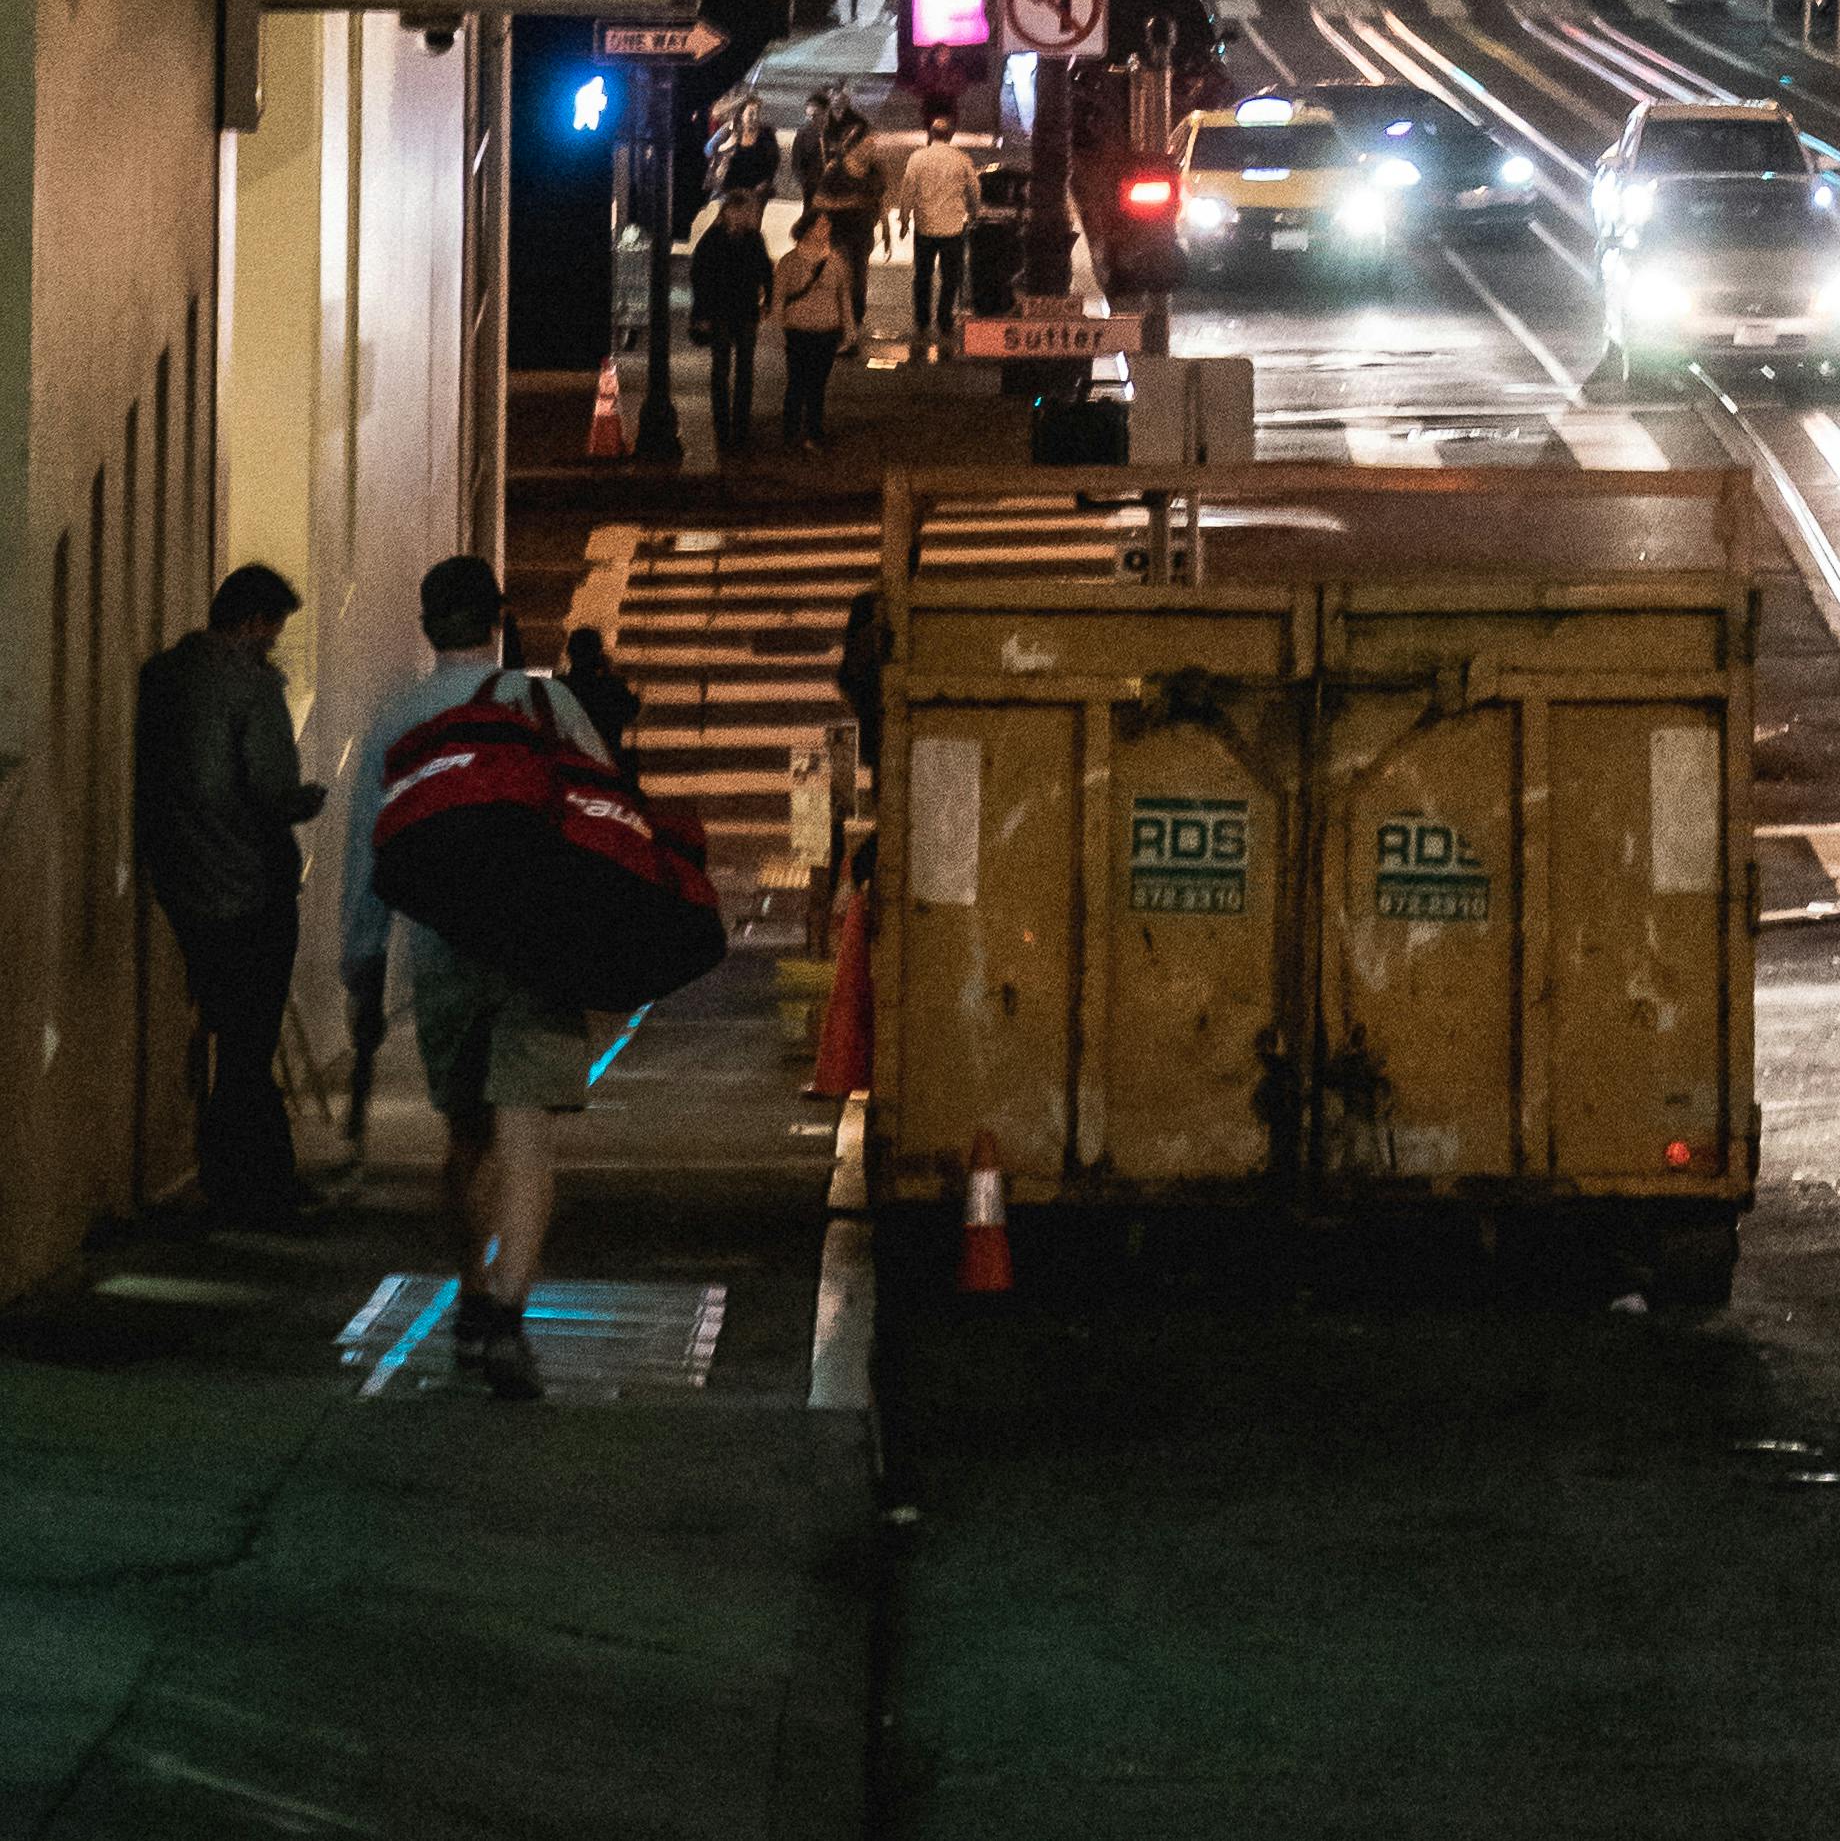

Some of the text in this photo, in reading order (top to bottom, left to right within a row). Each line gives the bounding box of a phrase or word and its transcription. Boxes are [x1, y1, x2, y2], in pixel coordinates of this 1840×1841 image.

[651, 31, 691, 52] WAY
[1003, 325, 1104, 351] Sutter
[1132, 819, 1246, 860] RDS
